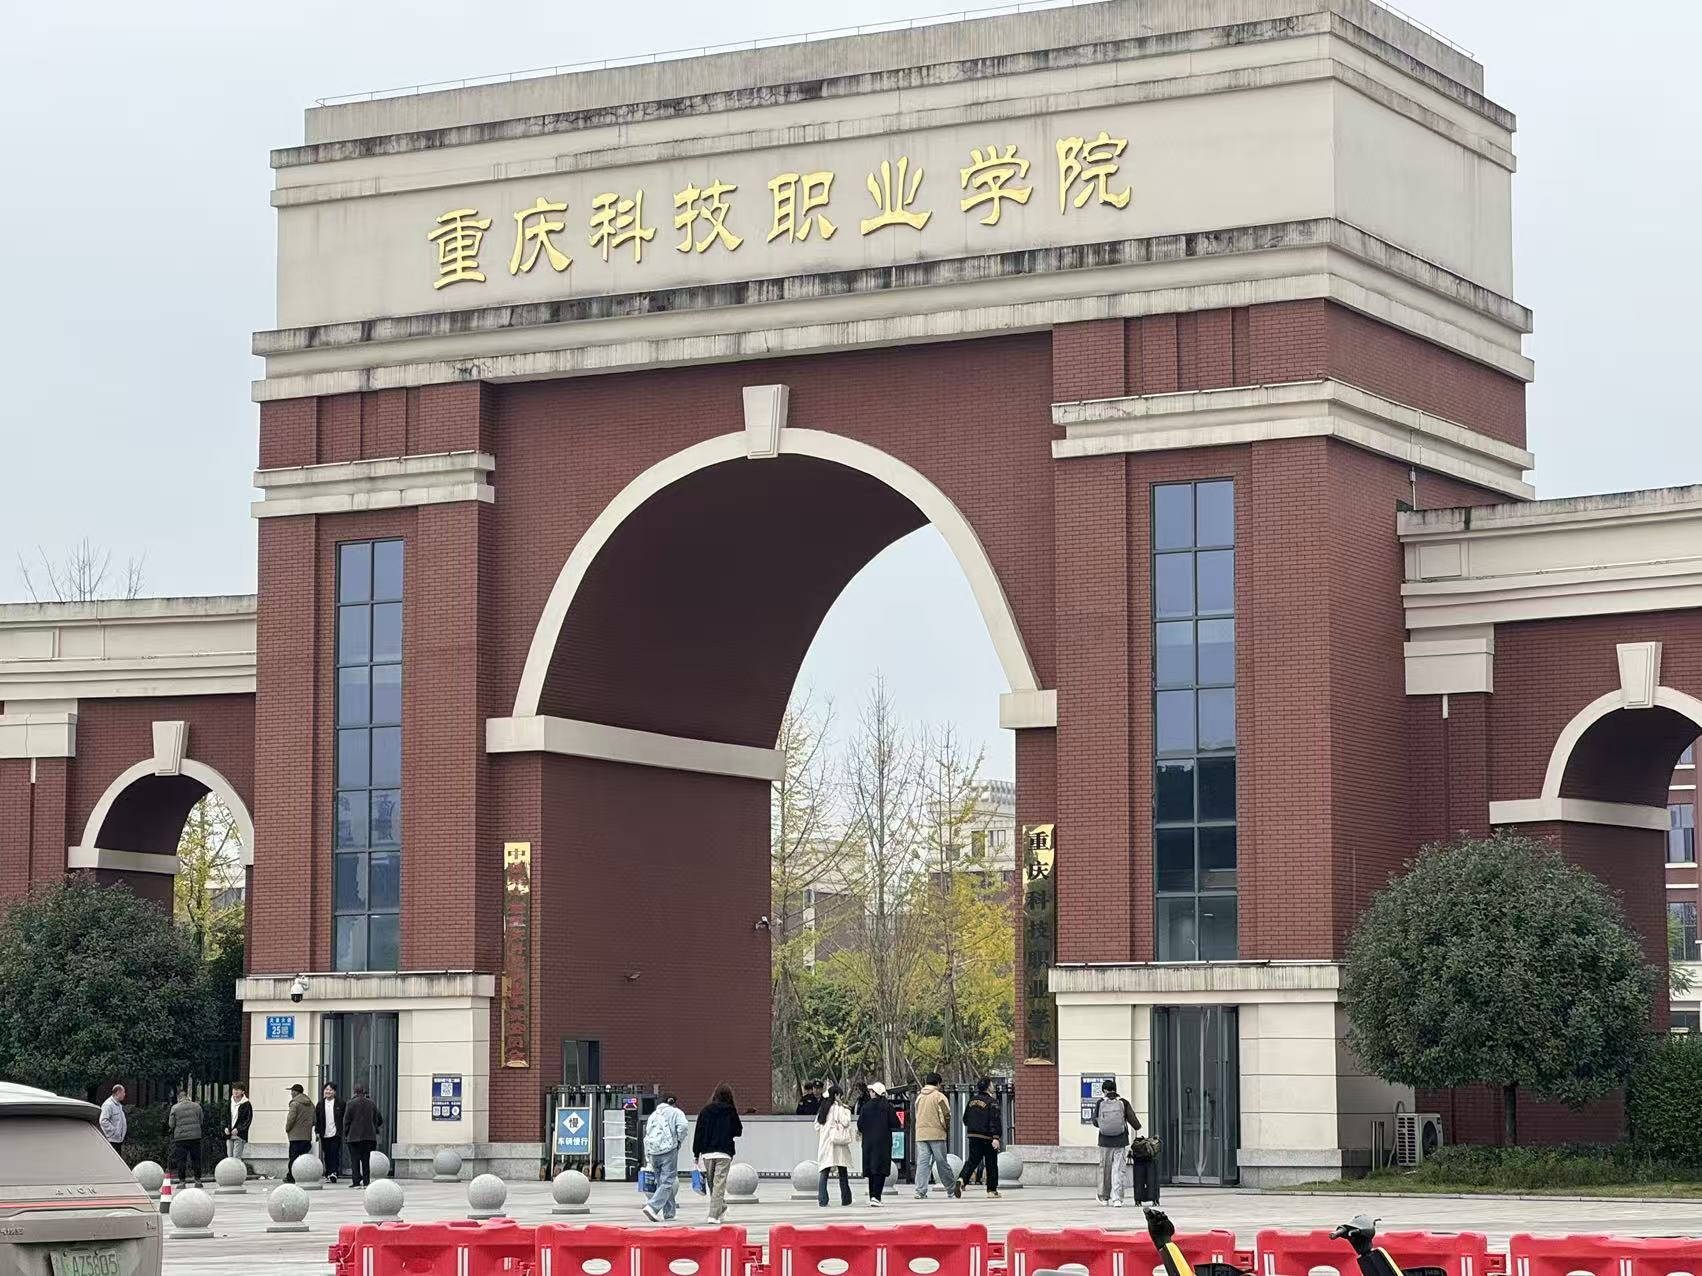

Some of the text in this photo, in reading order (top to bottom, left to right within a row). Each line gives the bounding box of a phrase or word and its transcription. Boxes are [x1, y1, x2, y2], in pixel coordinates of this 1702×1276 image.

[427, 131, 1132, 290] 重庆科技职业学院
[272, 1026, 281, 1035] 25
[569, 1117, 579, 1128] 慢
[558, 1137, 588, 1146] 车辆慢行
